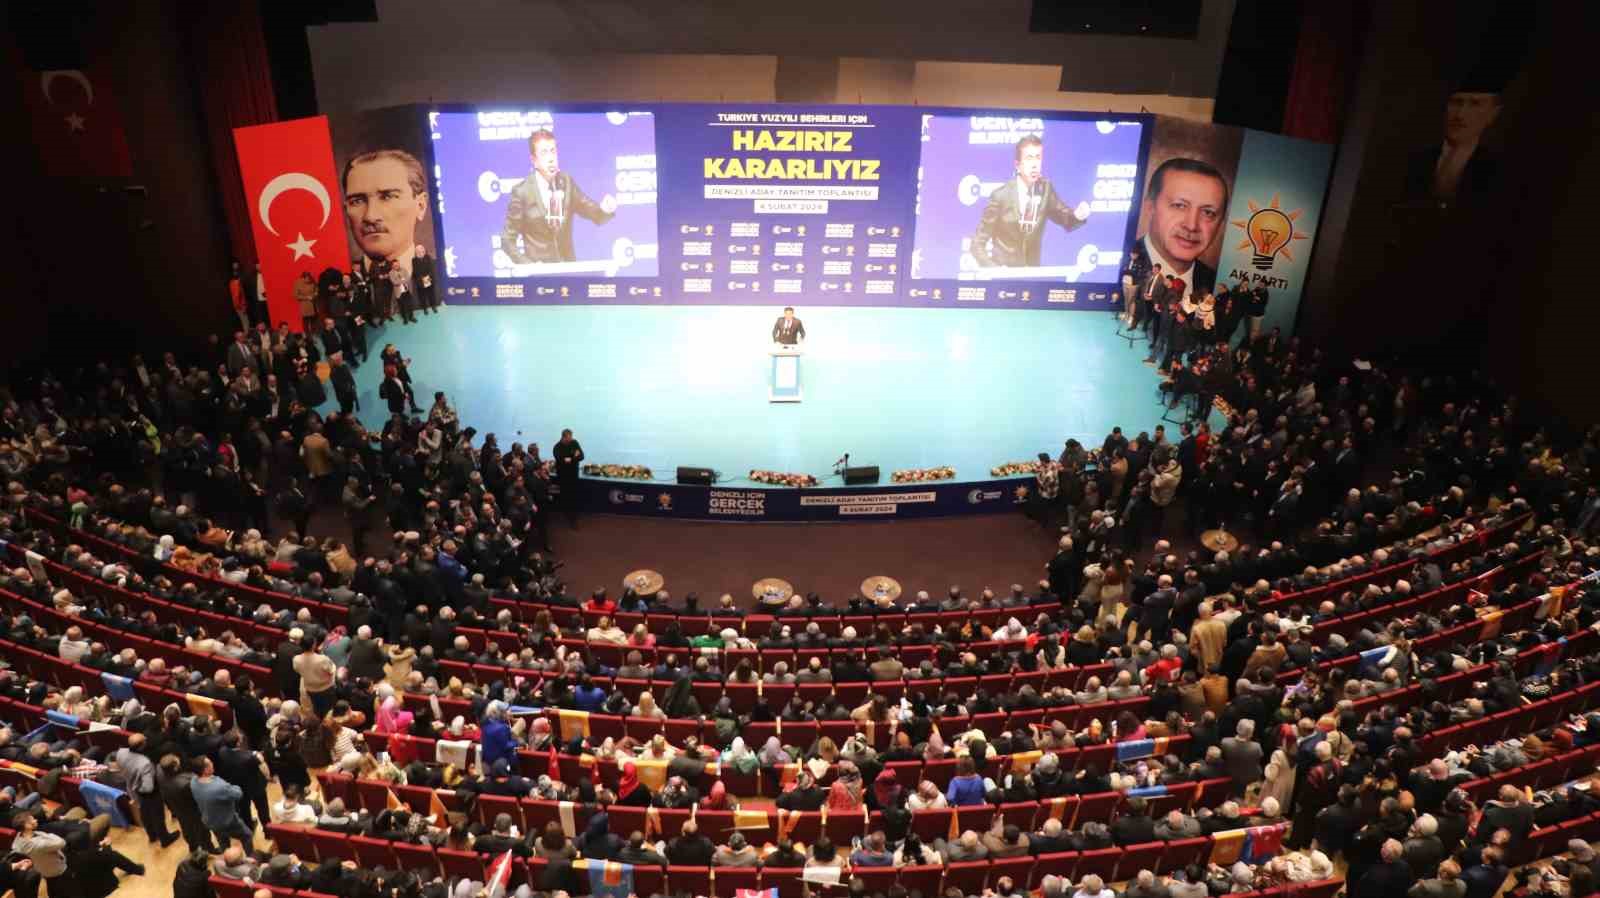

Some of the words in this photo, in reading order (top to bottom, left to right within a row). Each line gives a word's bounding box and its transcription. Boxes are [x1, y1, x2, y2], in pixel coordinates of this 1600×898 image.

[733, 130, 853, 152] HAZIRIZ
[704, 158, 880, 180] KARARLIYIZ
[1229, 269, 1248, 281] AK
